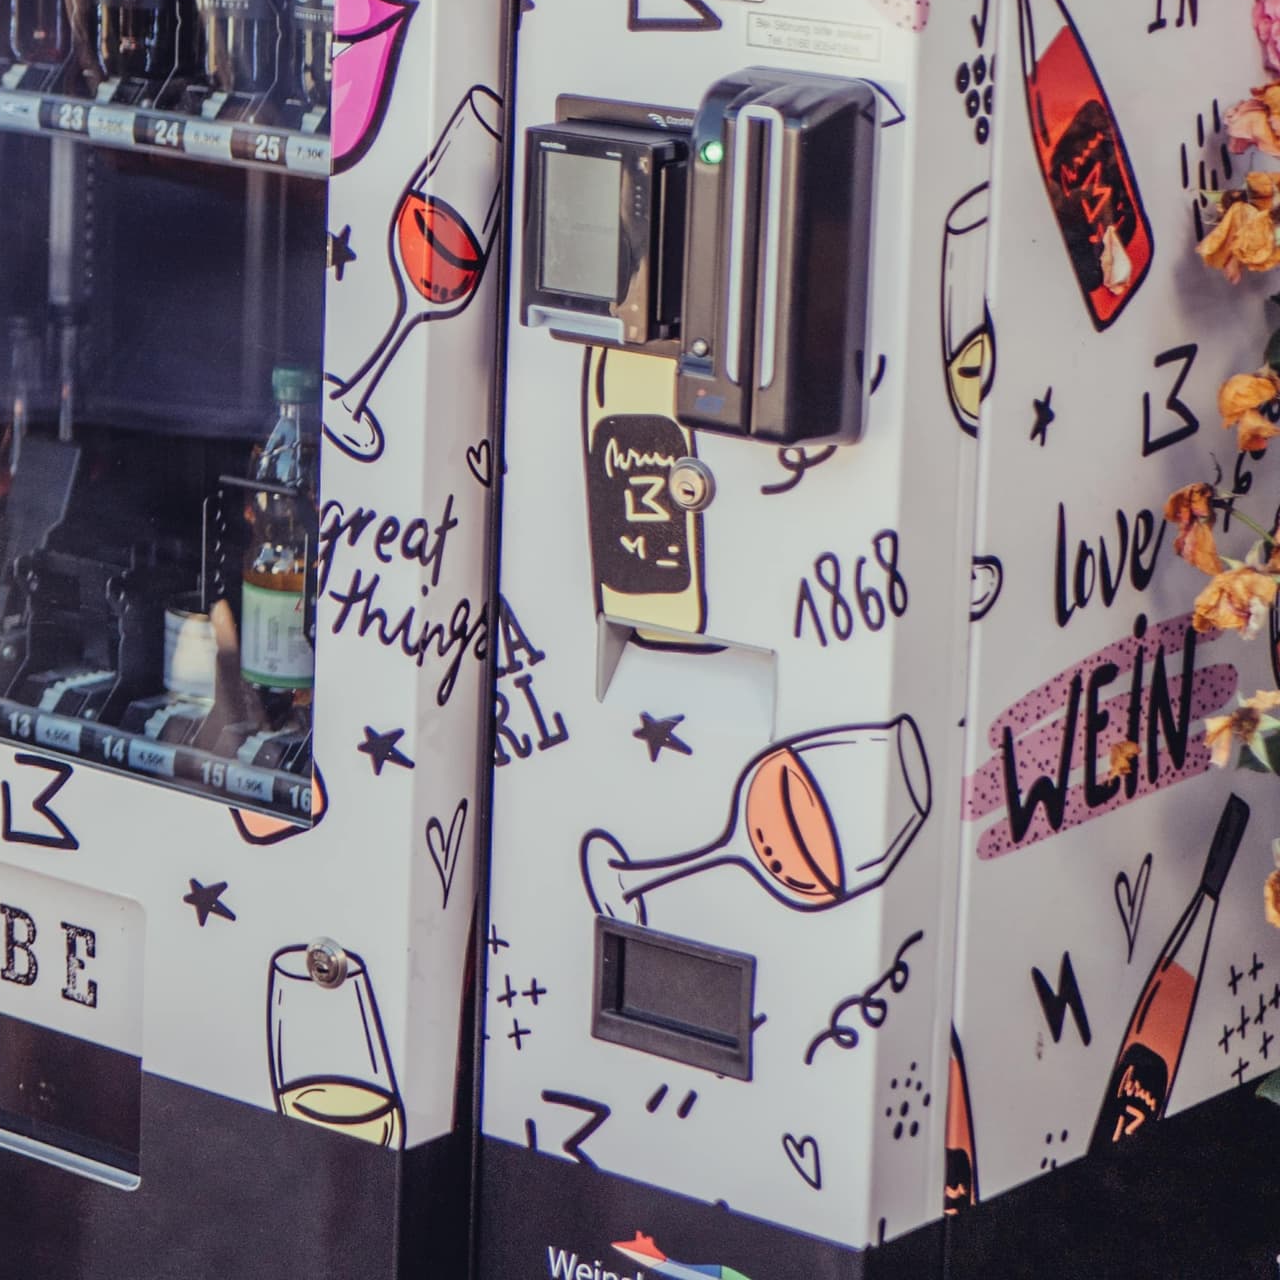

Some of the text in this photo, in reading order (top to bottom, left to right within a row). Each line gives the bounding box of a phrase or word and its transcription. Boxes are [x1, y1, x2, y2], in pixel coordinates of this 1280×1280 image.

[59, 103, 85, 130] 23
[154, 120, 180, 147] 24
[255, 134, 280, 161] 25
[318, 494, 458, 600] great
[1053, 502, 1170, 627] love
[794, 529, 907, 647] 1868
[9, 711, 31, 738] 13
[102, 735, 125, 762] 14
[201, 760, 224, 787] 15
[289, 784, 311, 812] 16
